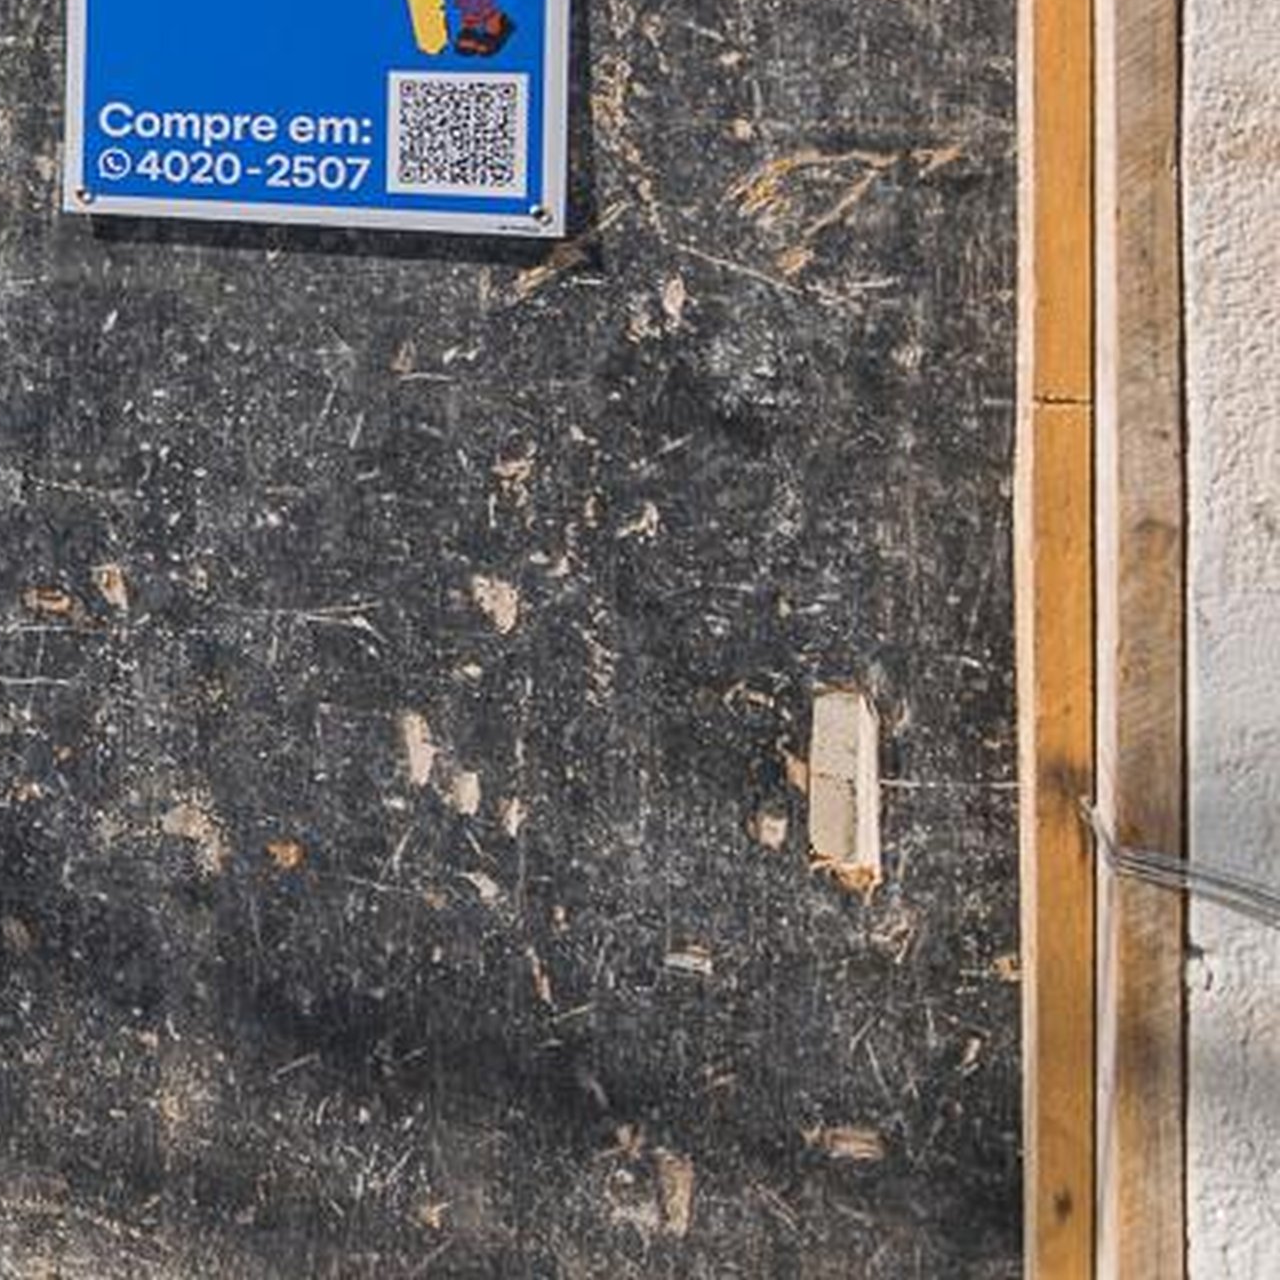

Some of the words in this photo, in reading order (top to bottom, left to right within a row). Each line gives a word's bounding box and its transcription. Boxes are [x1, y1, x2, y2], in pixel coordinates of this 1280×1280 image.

[98, 101, 279, 148] Compre
[289, 116, 373, 145] em:
[135, 149, 372, 191] 4020-2507
